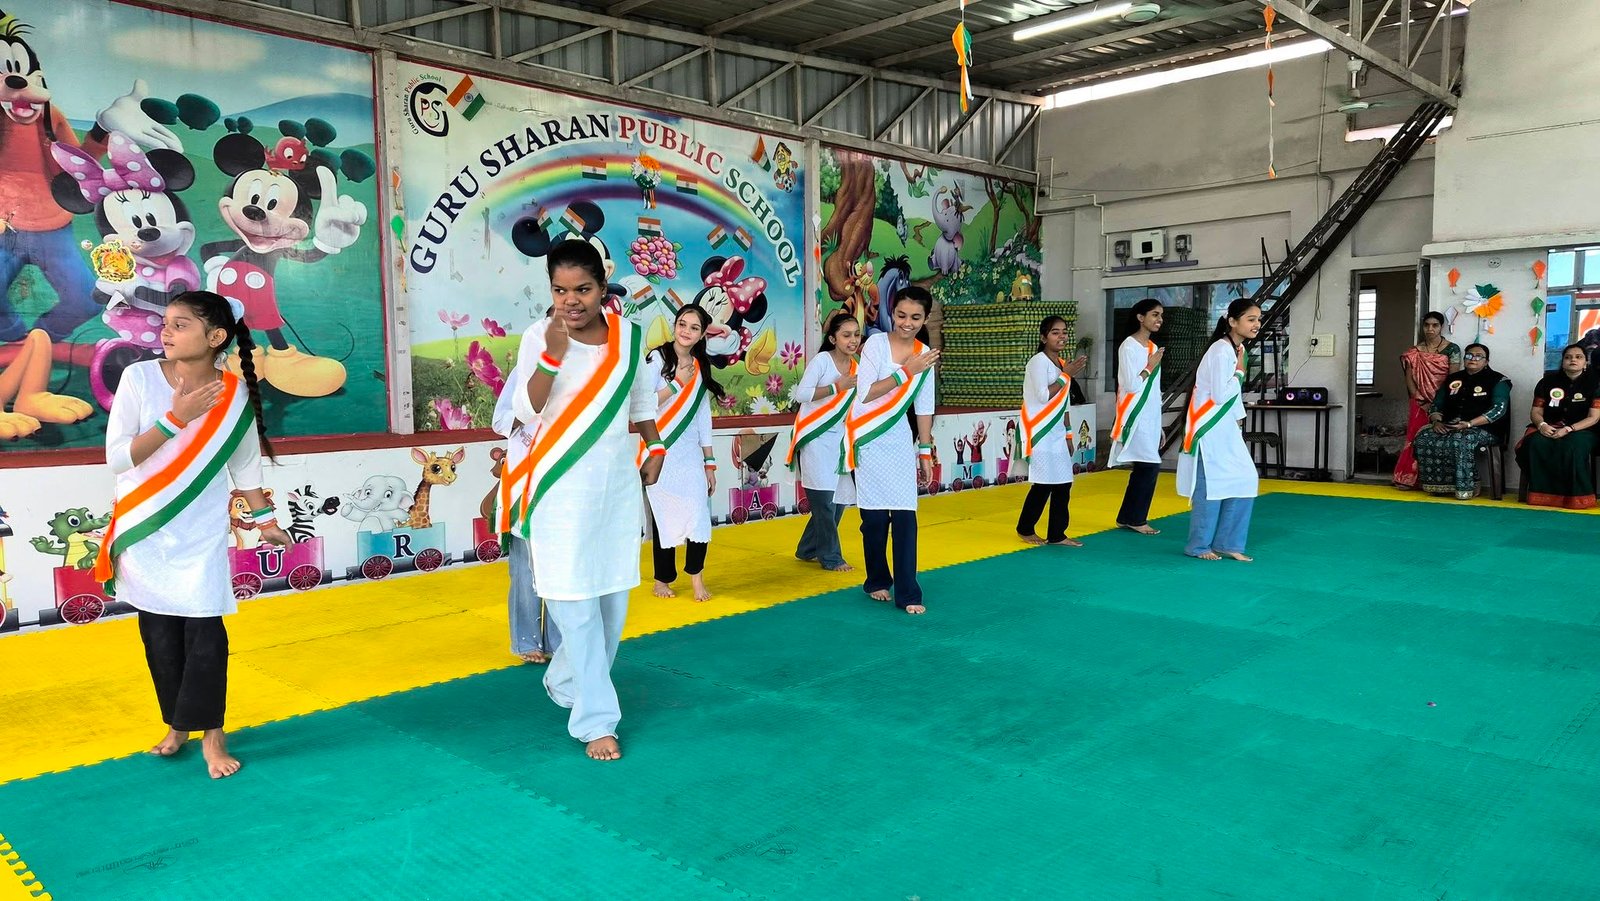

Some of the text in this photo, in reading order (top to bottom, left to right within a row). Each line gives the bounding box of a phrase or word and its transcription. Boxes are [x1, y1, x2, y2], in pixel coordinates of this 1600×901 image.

[419, 73, 442, 82] School
[410, 114, 799, 284] GURU SHARAN PUBLIC SCHOOL
[962, 465, 973, 480] M
[750, 491, 762, 508] A
[394, 535, 415, 558] R
[257, 549, 285, 576] U
